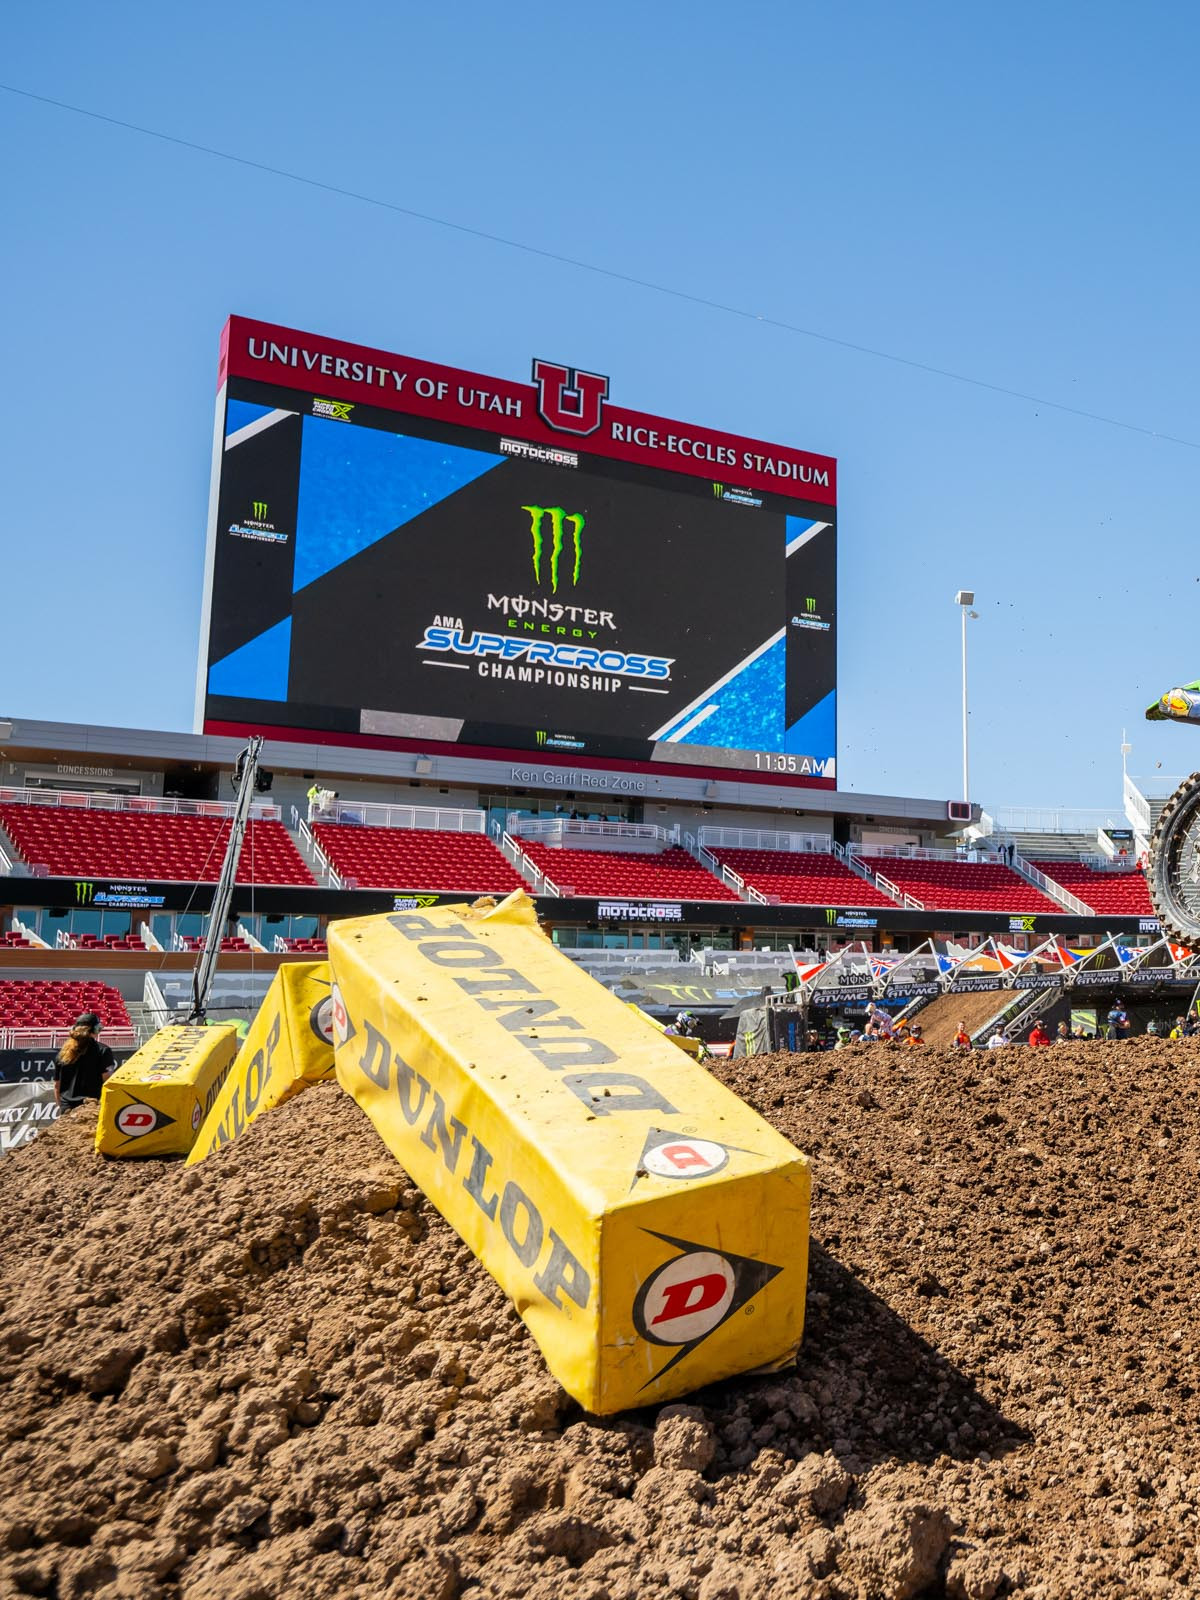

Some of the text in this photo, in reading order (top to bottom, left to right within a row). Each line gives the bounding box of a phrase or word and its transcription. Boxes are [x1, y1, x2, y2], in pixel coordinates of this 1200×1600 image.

[248, 337, 522, 419] UNIVERSITY OF UTAH
[531, 358, 609, 436] U
[500, 441, 578, 466] MOTOCROSS
[611, 421, 830, 488] RICE-ECCLES STADIUM
[433, 615, 464, 630] AMA
[487, 593, 617, 630] MONSTER
[508, 619, 598, 640] ENERGY
[415, 625, 676, 680] SUPERCROSS
[478, 661, 622, 693] CHAMPIONSHIP
[57, 764, 114, 777] CONCESSIONS
[754, 752, 825, 774] 11:05 AM
[511, 768, 645, 790] Ken Garff Red Zone
[598, 906, 682, 918] MOTOCROSS
[387, 914, 680, 1117] DUNLOP
[20, 1060, 57, 1072] UTA
[121, 1113, 153, 1127] D
[358, 1019, 591, 1311] DUNLOP
[651, 1273, 729, 1326] D
